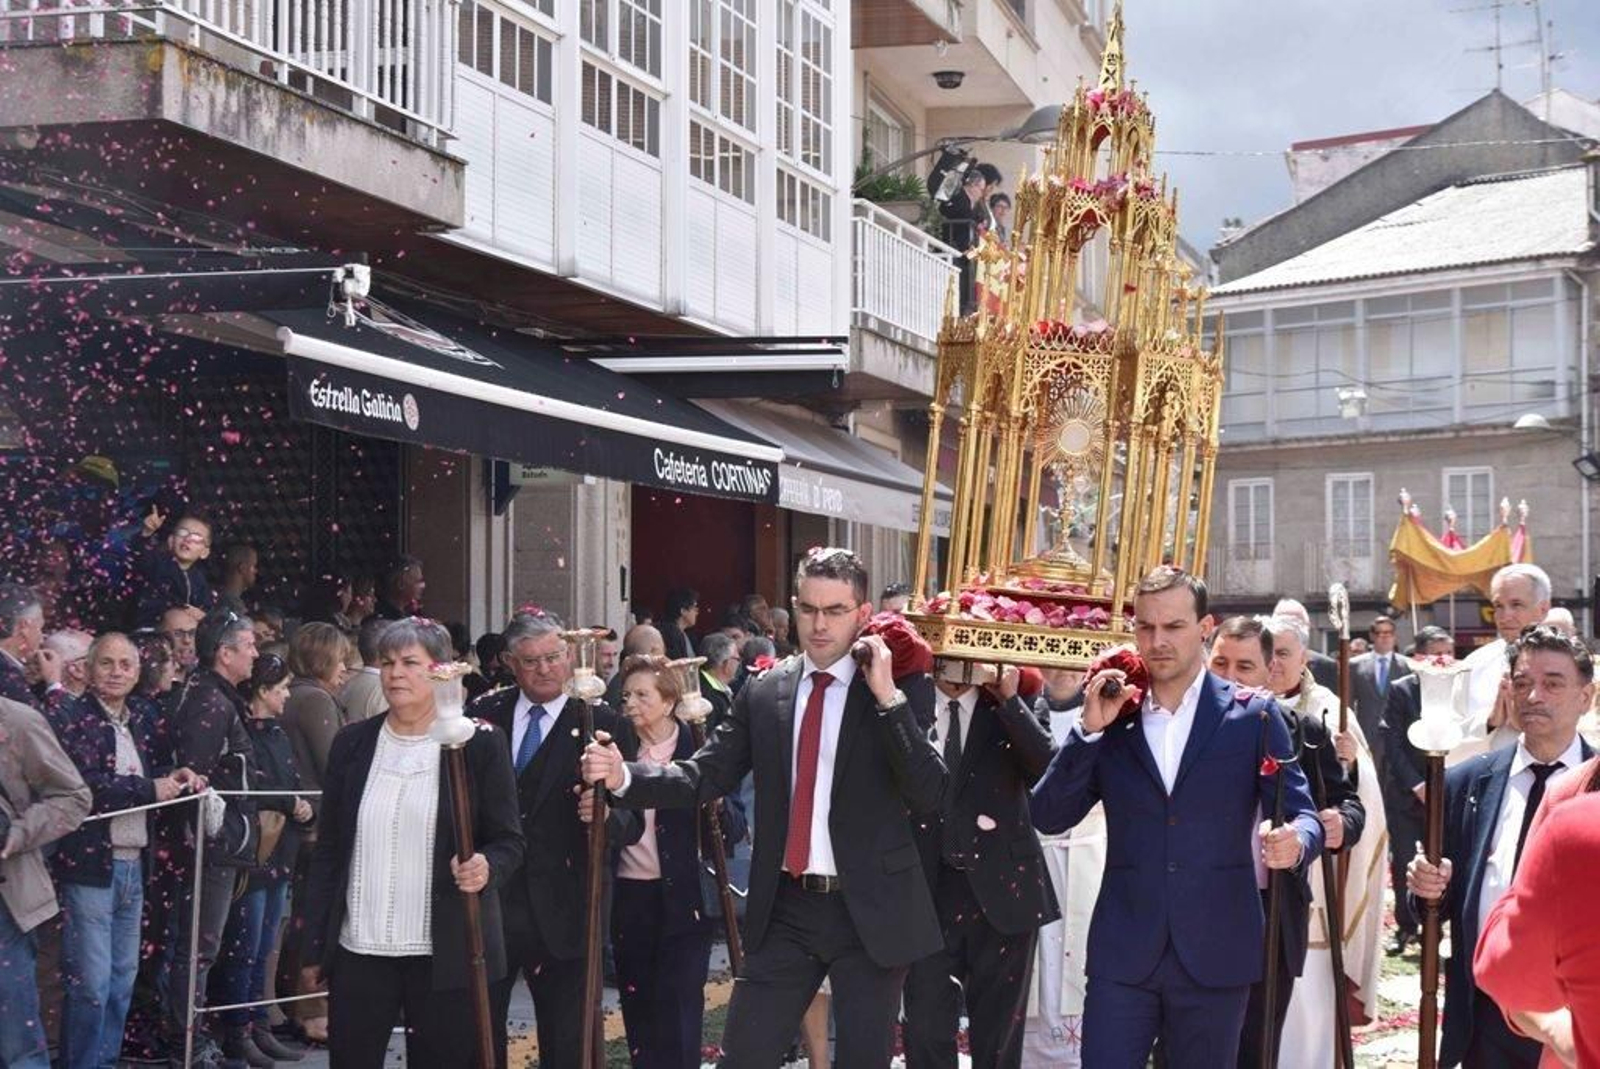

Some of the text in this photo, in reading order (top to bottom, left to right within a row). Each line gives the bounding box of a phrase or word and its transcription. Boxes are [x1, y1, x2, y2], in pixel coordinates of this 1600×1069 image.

[310, 379, 402, 422] Estrella Galicia
[653, 447, 772, 496] Cafetería CORTIÑAS
